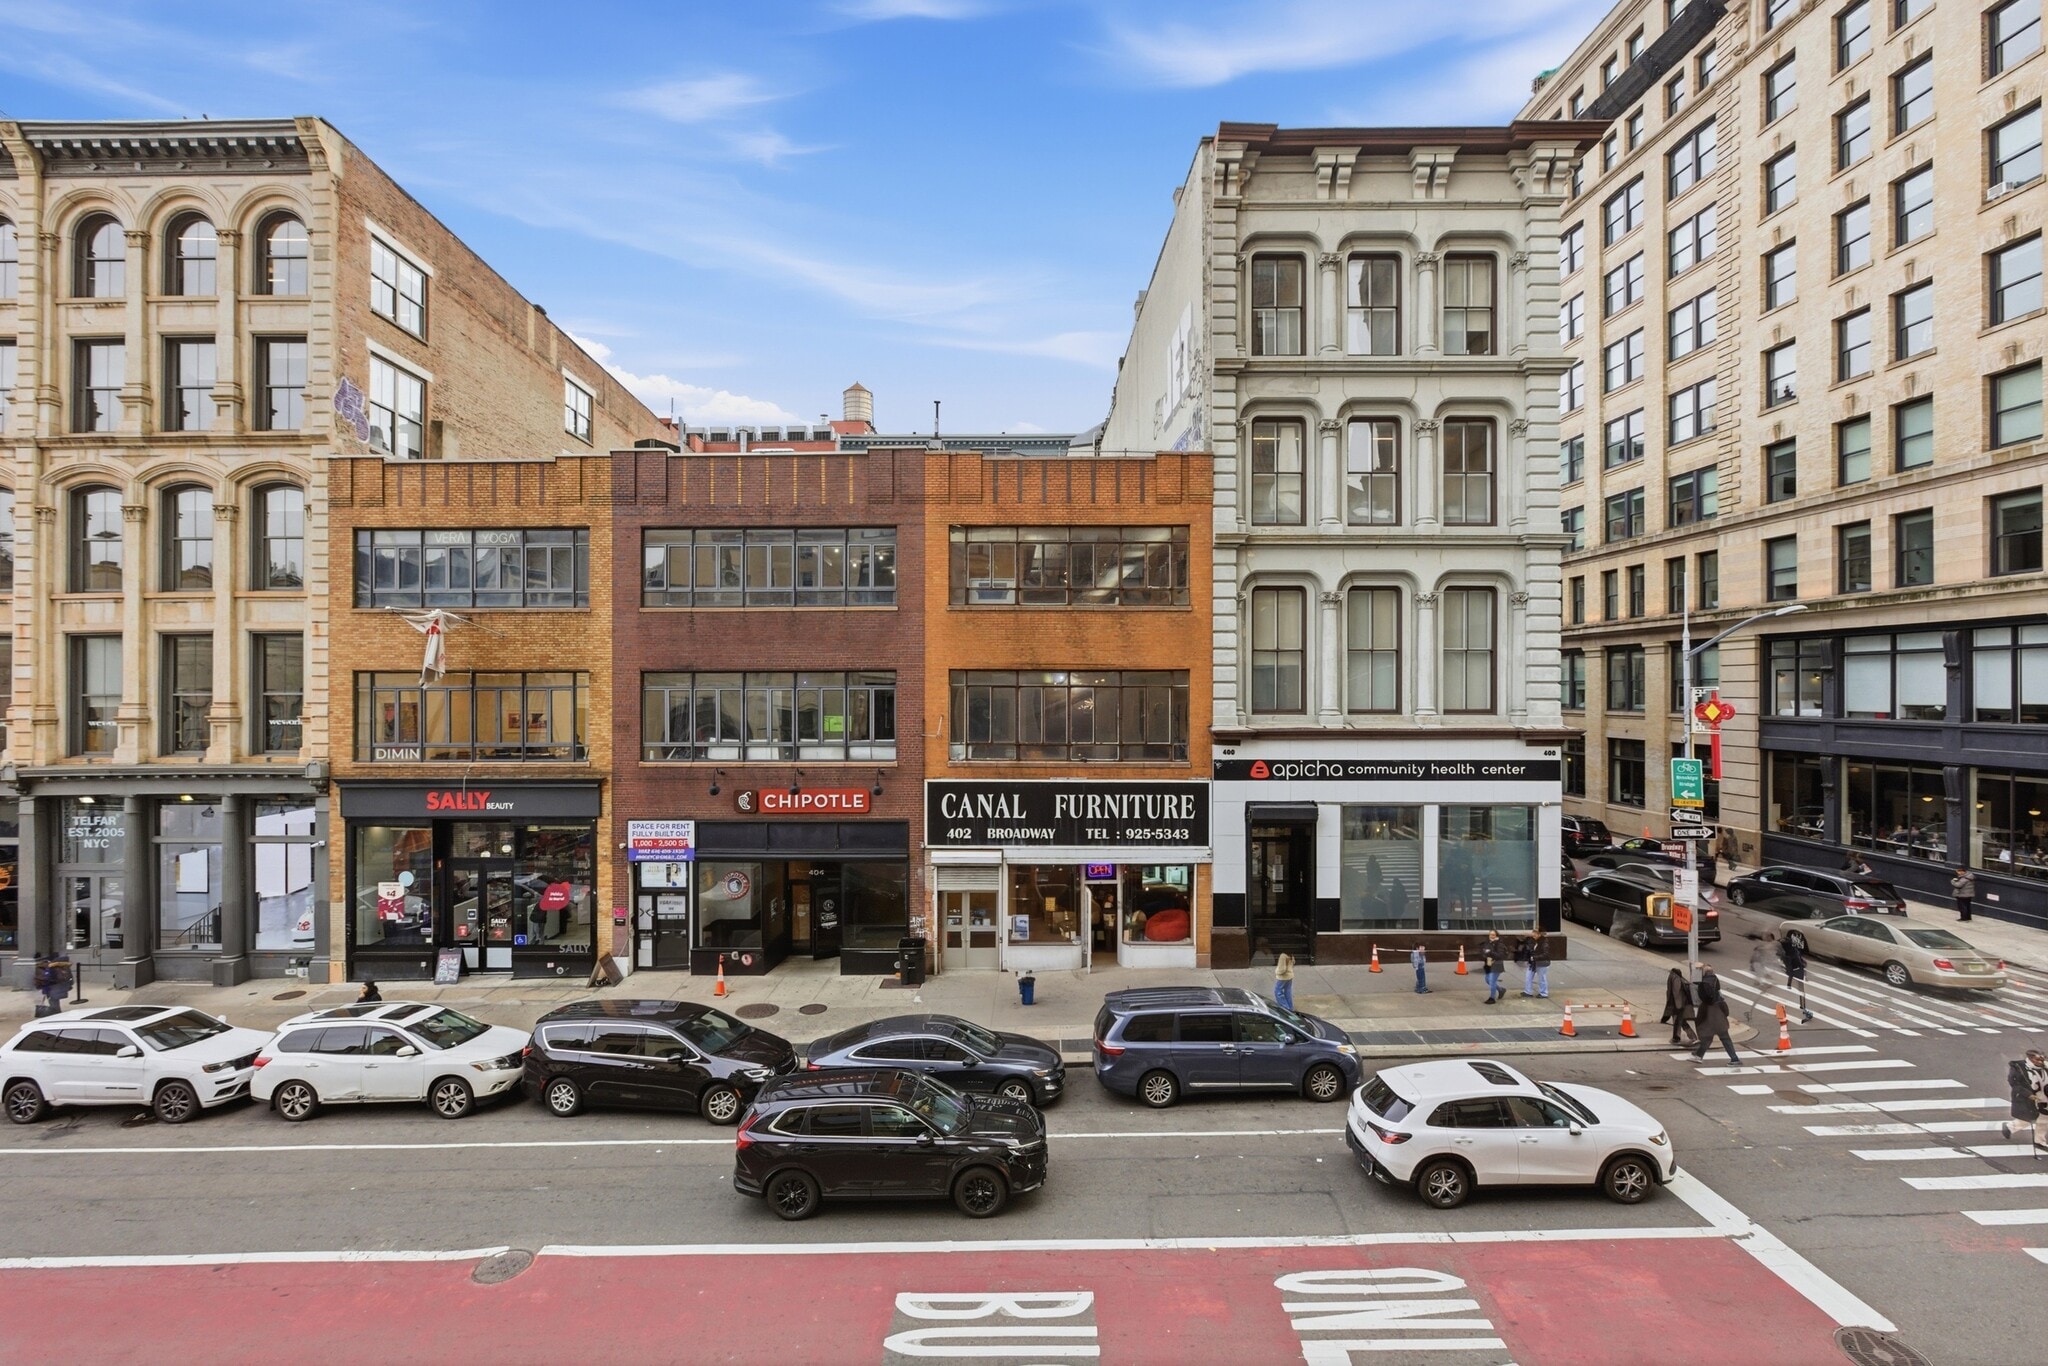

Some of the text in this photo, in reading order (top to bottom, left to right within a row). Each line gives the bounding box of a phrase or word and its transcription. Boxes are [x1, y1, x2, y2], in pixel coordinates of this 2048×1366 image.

[434, 532, 517, 544] VERA YOGA
[375, 748, 420, 760] DIMIN
[1272, 760, 1526, 780] apicha community health center
[426, 791, 514, 810] SALLY BEAUTY
[764, 794, 864, 808] CHIPOTLE
[941, 793, 1196, 819] CANAL FURNITURE
[71, 816, 117, 826] TELFAR
[68, 828, 125, 837] EST. 2005
[946, 828, 972, 840] 402
[987, 828, 1056, 839] BROADWAY
[1085, 828, 1110, 839] TEL
[83, 839, 110, 848] NYC
[634, 840, 653, 848] 1,000
[558, 944, 591, 953] SALLY
